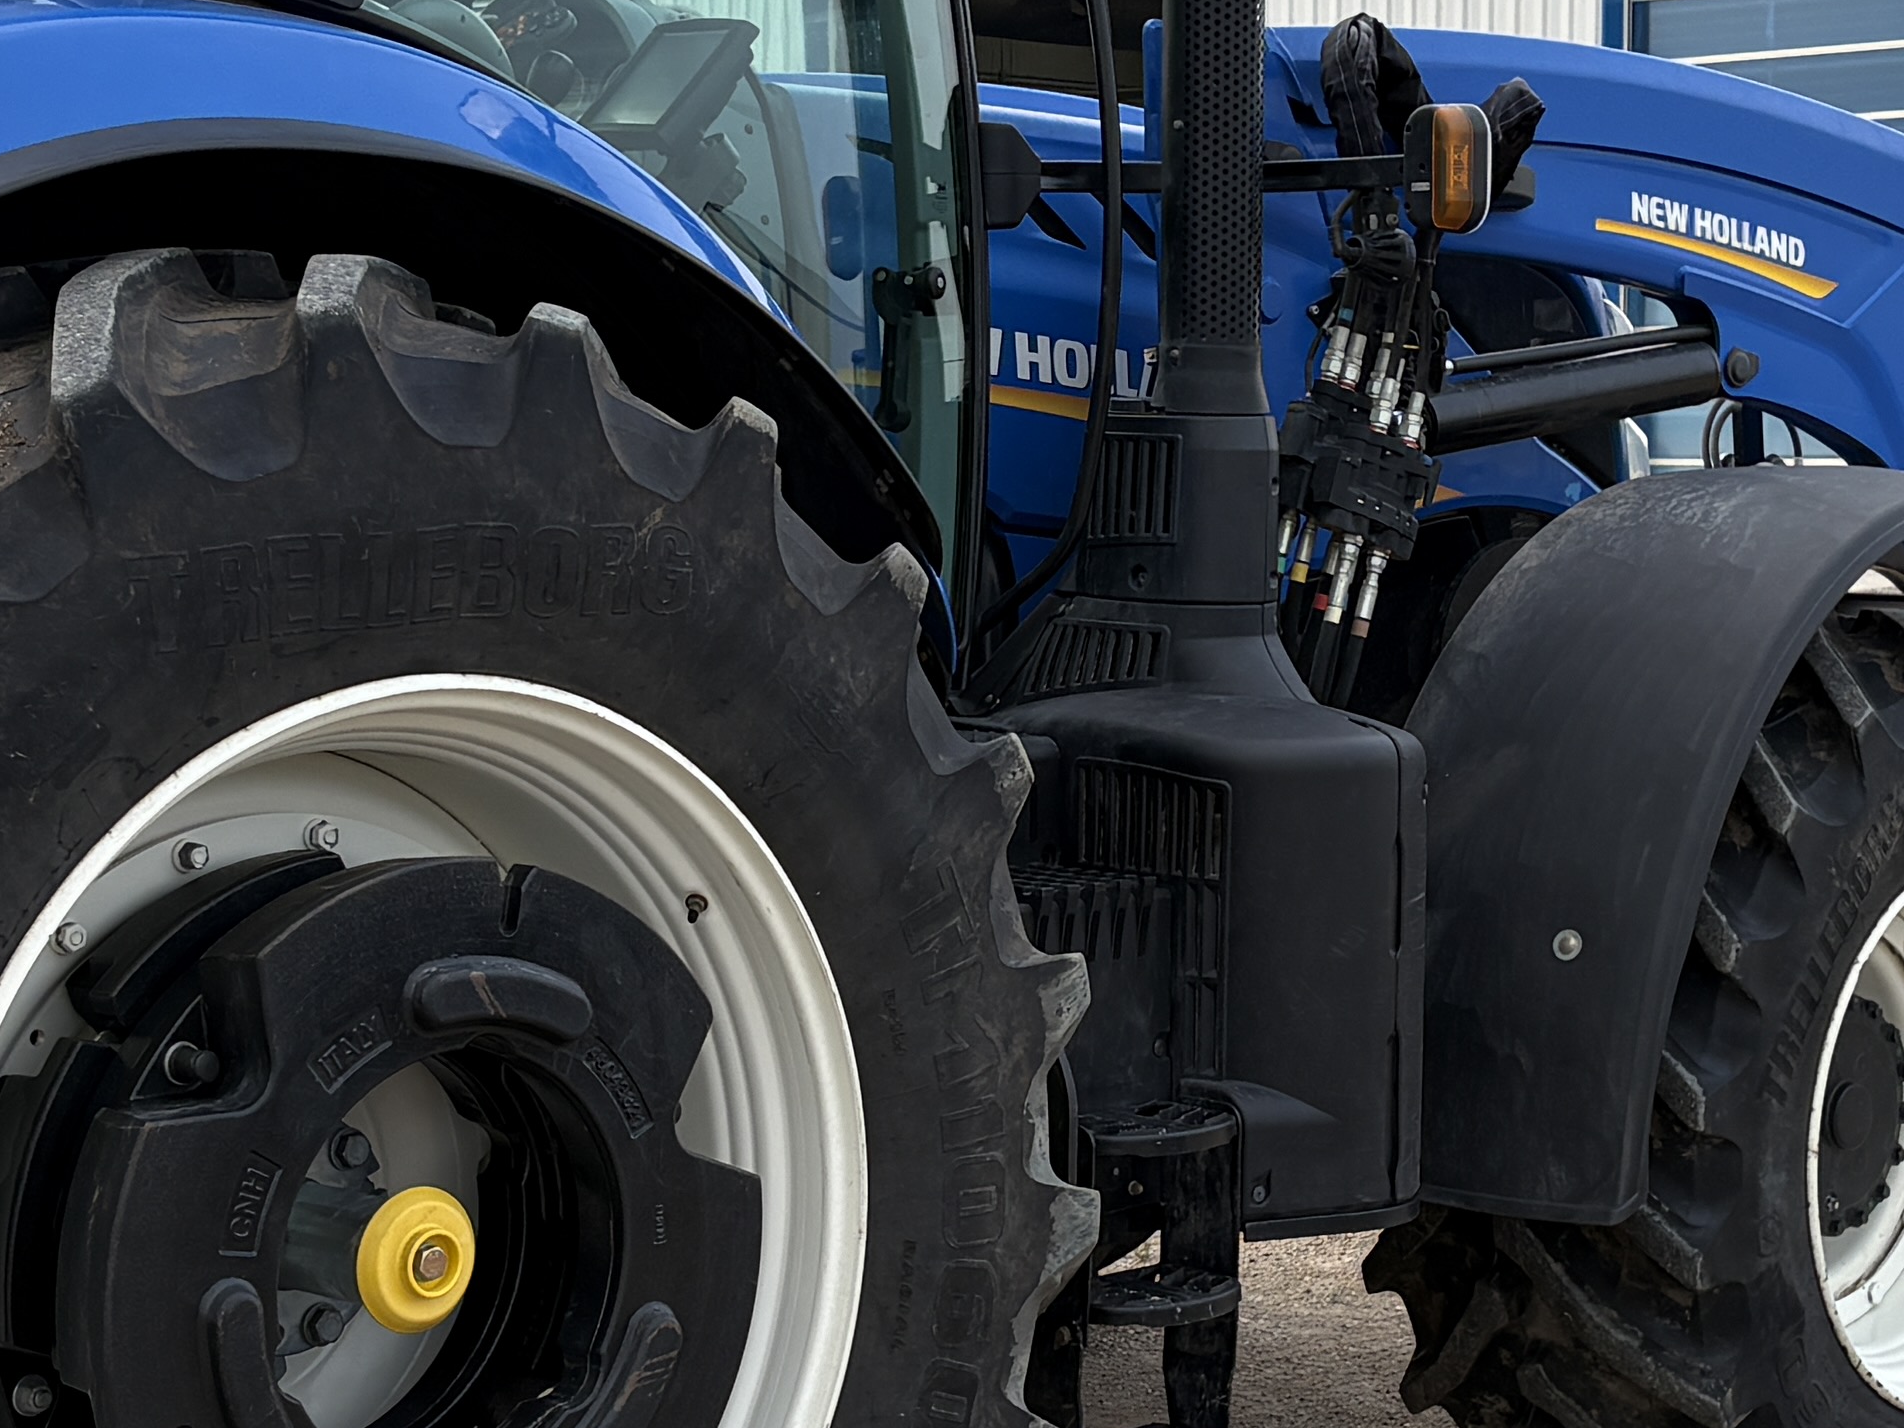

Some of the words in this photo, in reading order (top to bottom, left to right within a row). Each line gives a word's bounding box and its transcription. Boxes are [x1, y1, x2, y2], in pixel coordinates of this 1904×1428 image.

[1631, 191, 1689, 232] NEW
[1694, 207, 1806, 268] HOLLAND
[124, 520, 697, 655] TRELLEBORG
[317, 1013, 379, 1078] ITALY
